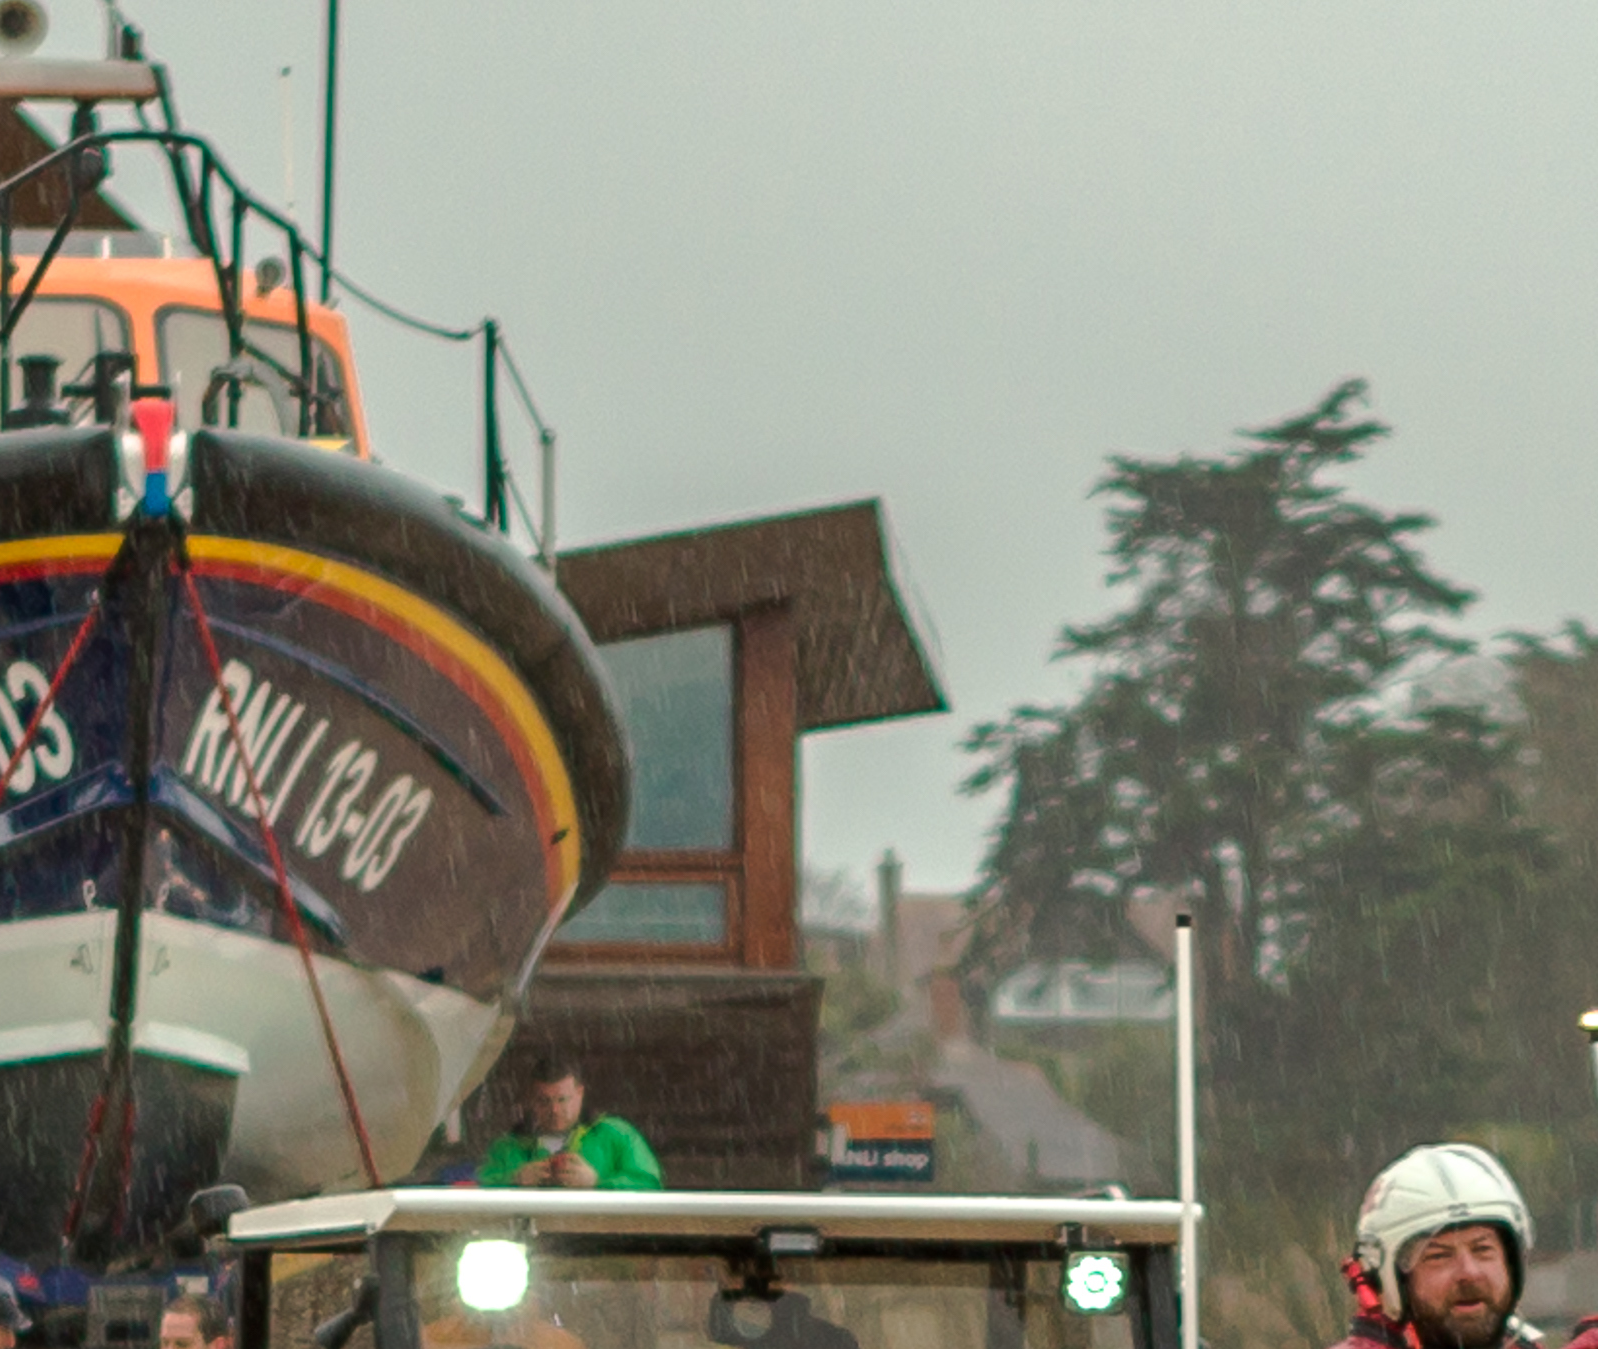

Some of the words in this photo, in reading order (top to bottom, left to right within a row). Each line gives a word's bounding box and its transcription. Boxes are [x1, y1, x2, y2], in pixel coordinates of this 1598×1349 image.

[184, 659, 330, 829] RNLI
[295, 740, 434, 892] 13-03
[883, 1149, 929, 1171] shop
